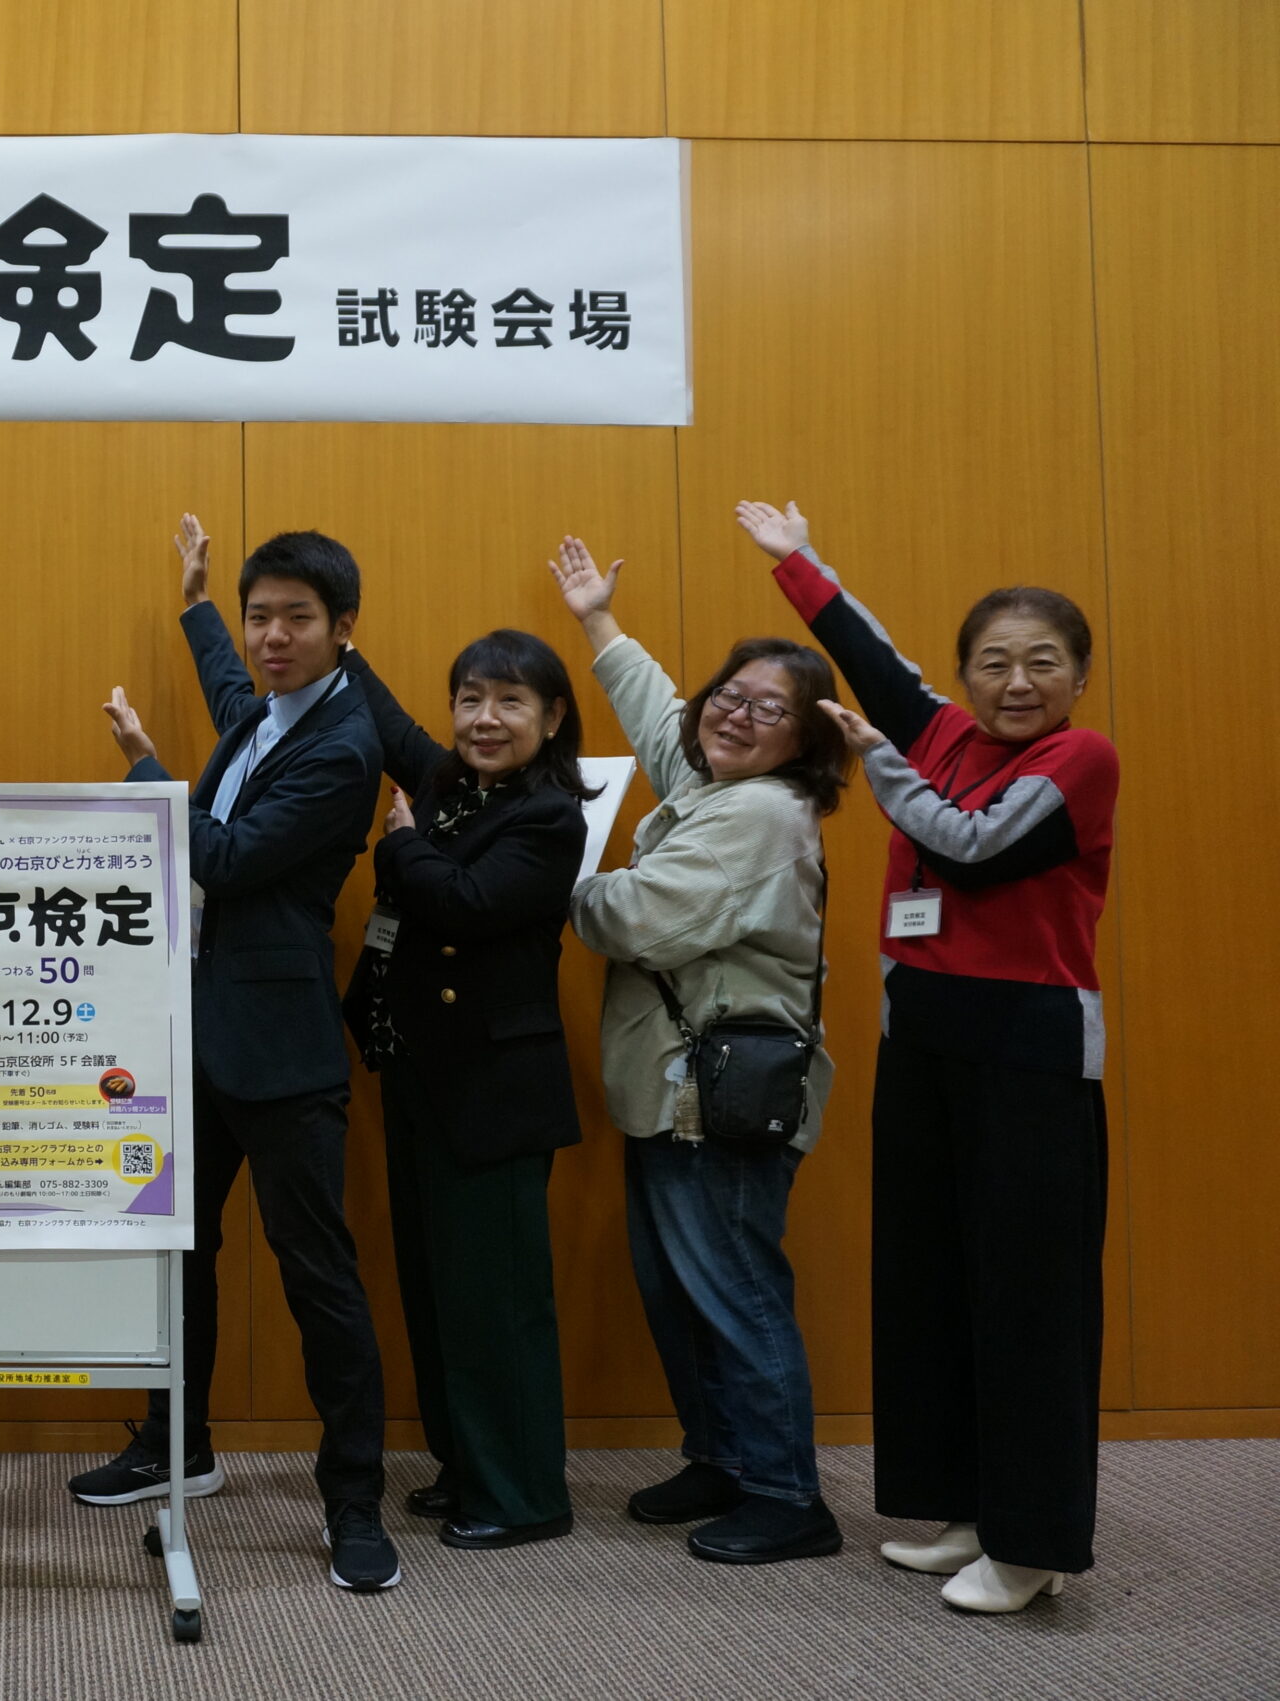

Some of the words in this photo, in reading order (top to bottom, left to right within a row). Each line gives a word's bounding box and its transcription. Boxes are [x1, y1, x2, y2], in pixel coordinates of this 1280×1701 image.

[336, 287, 631, 352] 試験会場
[18, 834, 152, 845] 右京ファンクラブねっとコラボ企画
[2, 999, 73, 1026] 12.9
[60, 1055, 77, 1066] 5F
[81, 1054, 117, 1067] 会議室
[40, 1180, 108, 1189] 075-882-3309
